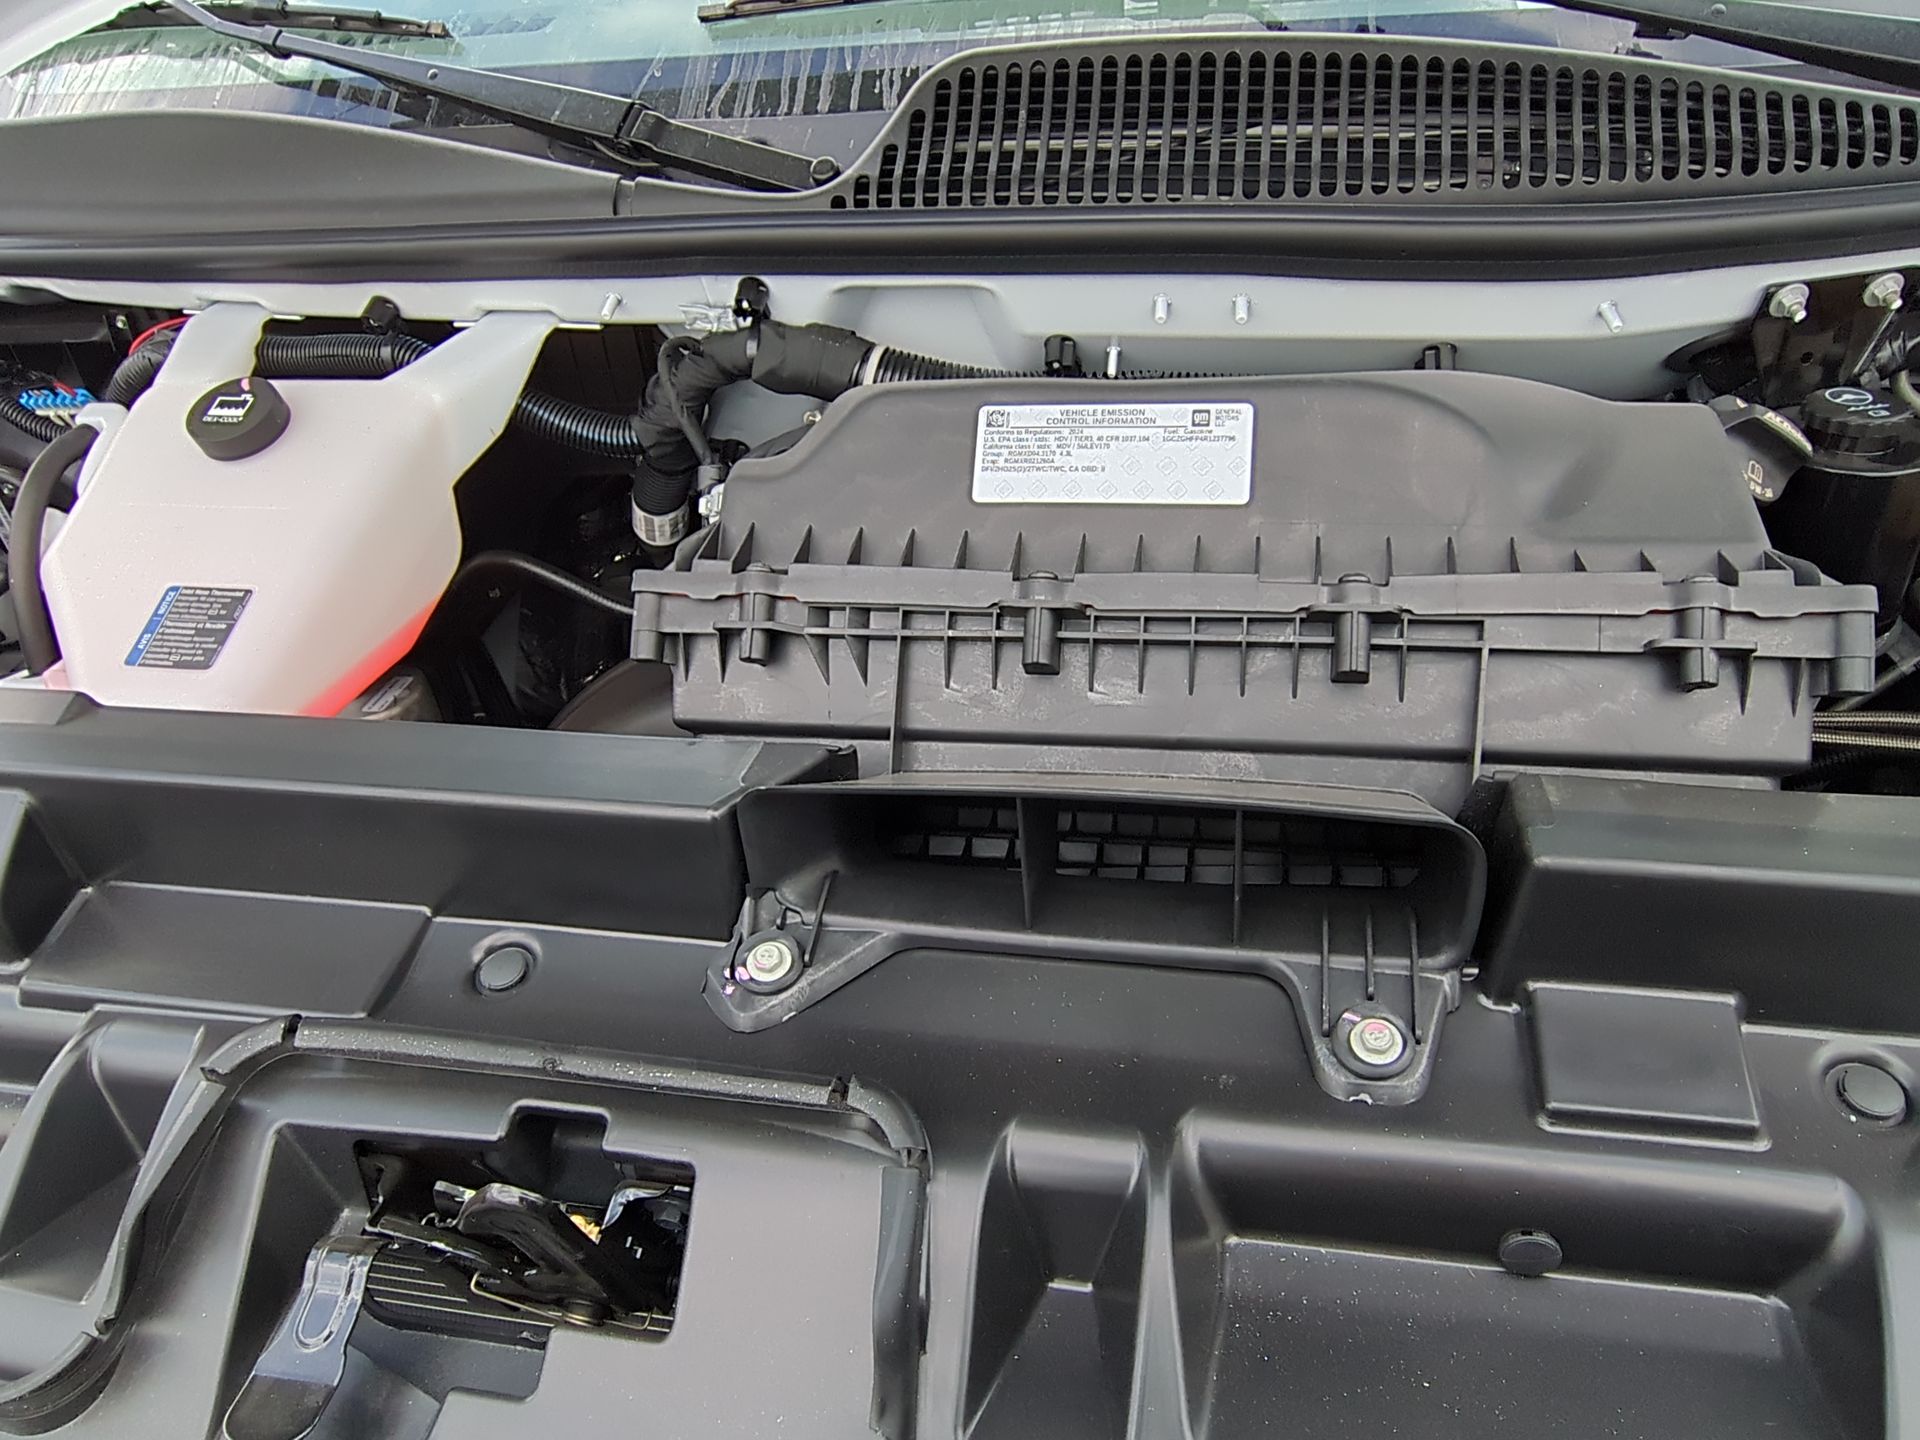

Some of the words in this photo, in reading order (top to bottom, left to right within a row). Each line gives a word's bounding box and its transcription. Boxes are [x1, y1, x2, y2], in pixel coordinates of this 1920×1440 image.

[1060, 409, 1098, 417] VEHICLE
[1101, 408, 1146, 416] EMISSION
[1046, 417, 1090, 425] CONTROL
[1092, 416, 1157, 425] INFORMATION
[1024, 429, 1064, 437] Regulations:
[982, 450, 1004, 458] Group:
[157, 590, 177, 615] NOTICE
[137, 633, 152, 650] AVIS
